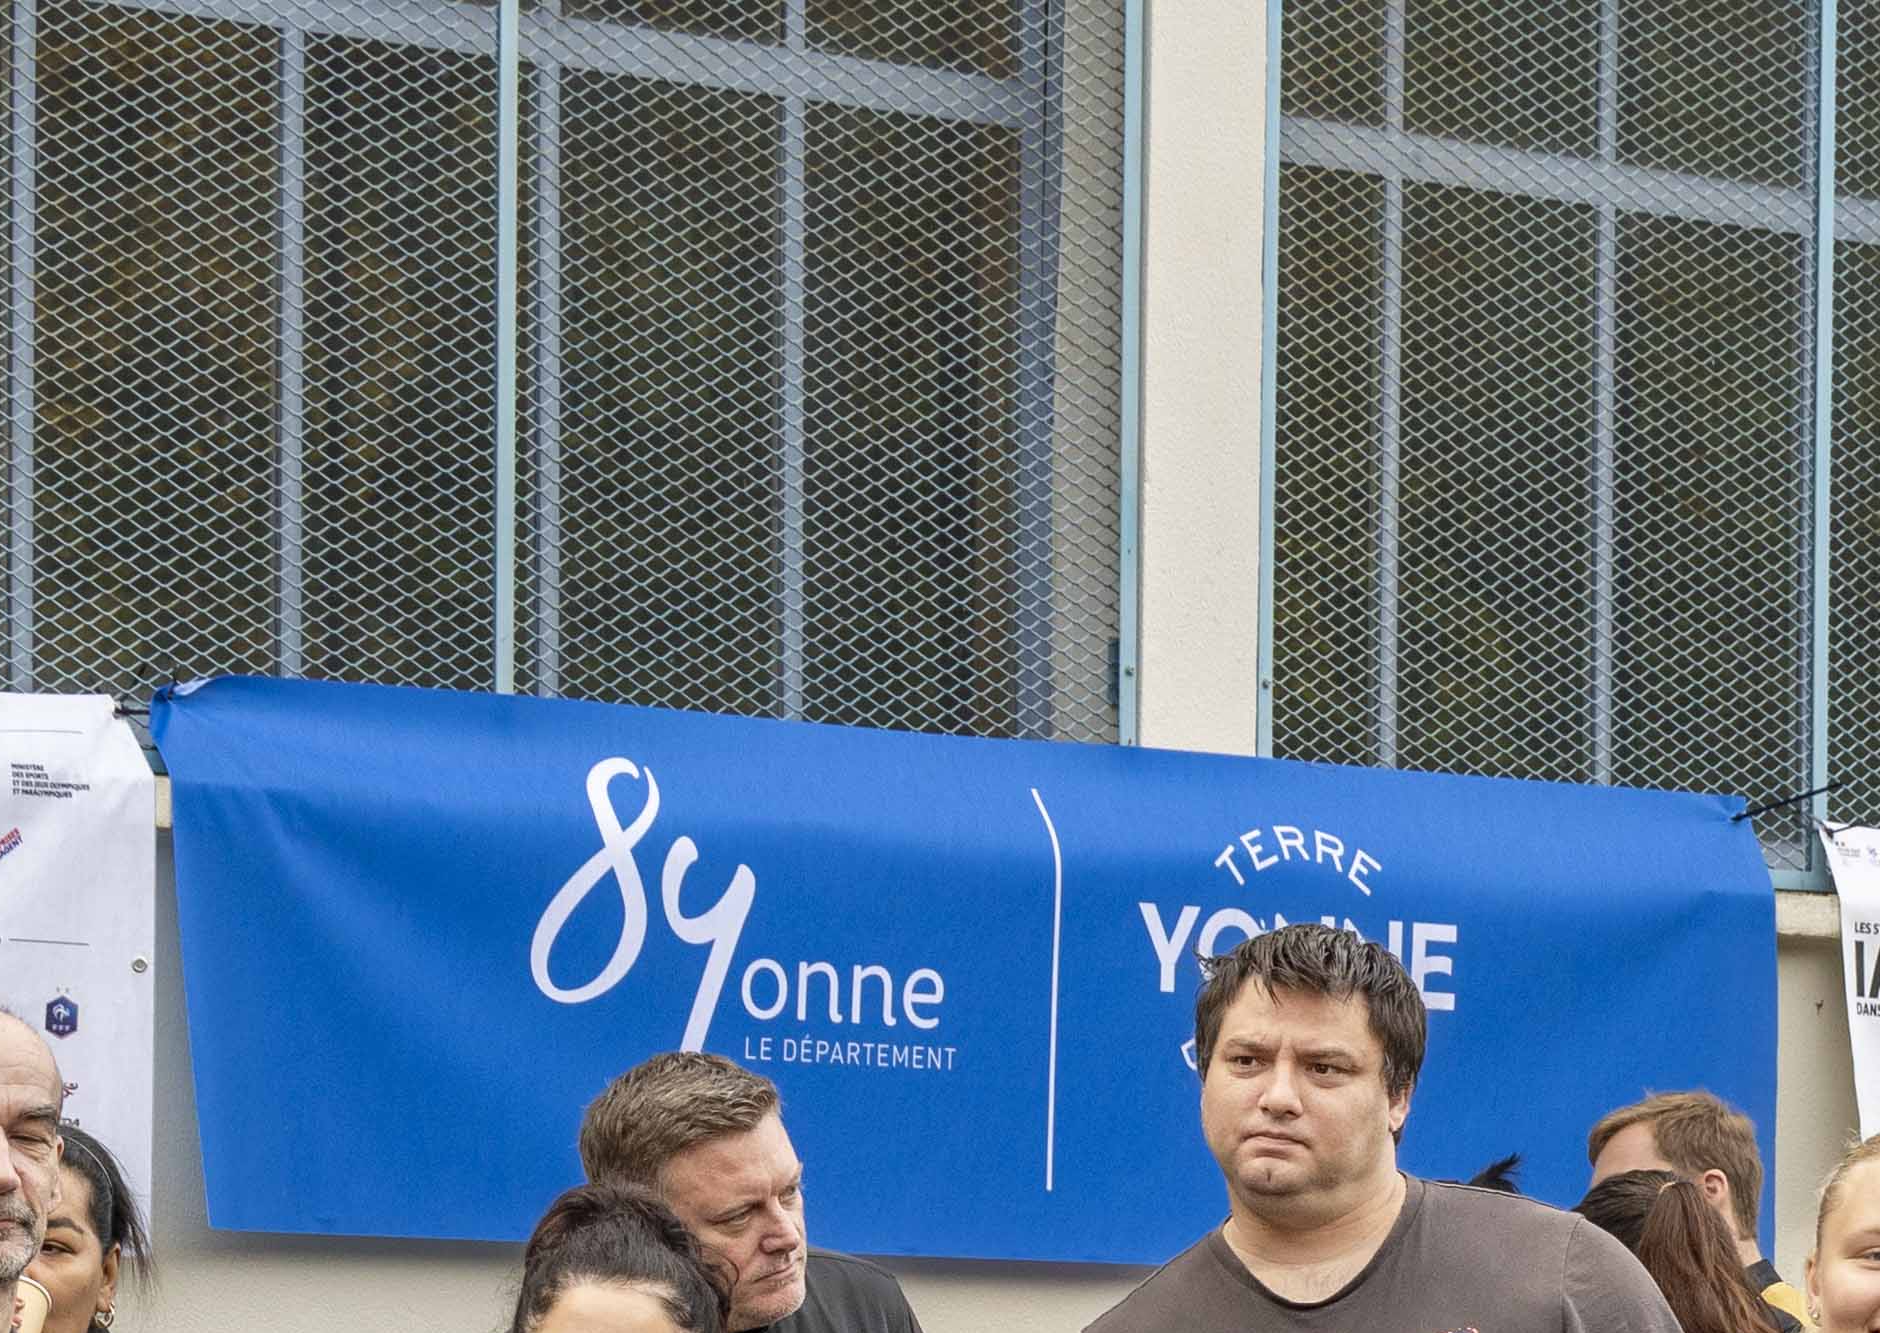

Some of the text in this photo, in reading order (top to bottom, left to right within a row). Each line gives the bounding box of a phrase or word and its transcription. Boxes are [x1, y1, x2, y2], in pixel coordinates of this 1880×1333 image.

[1214, 824, 1383, 897] TERRE
[1854, 922, 1871, 934] LES
[744, 1033, 957, 1071] LE DÉPARTEMENT
